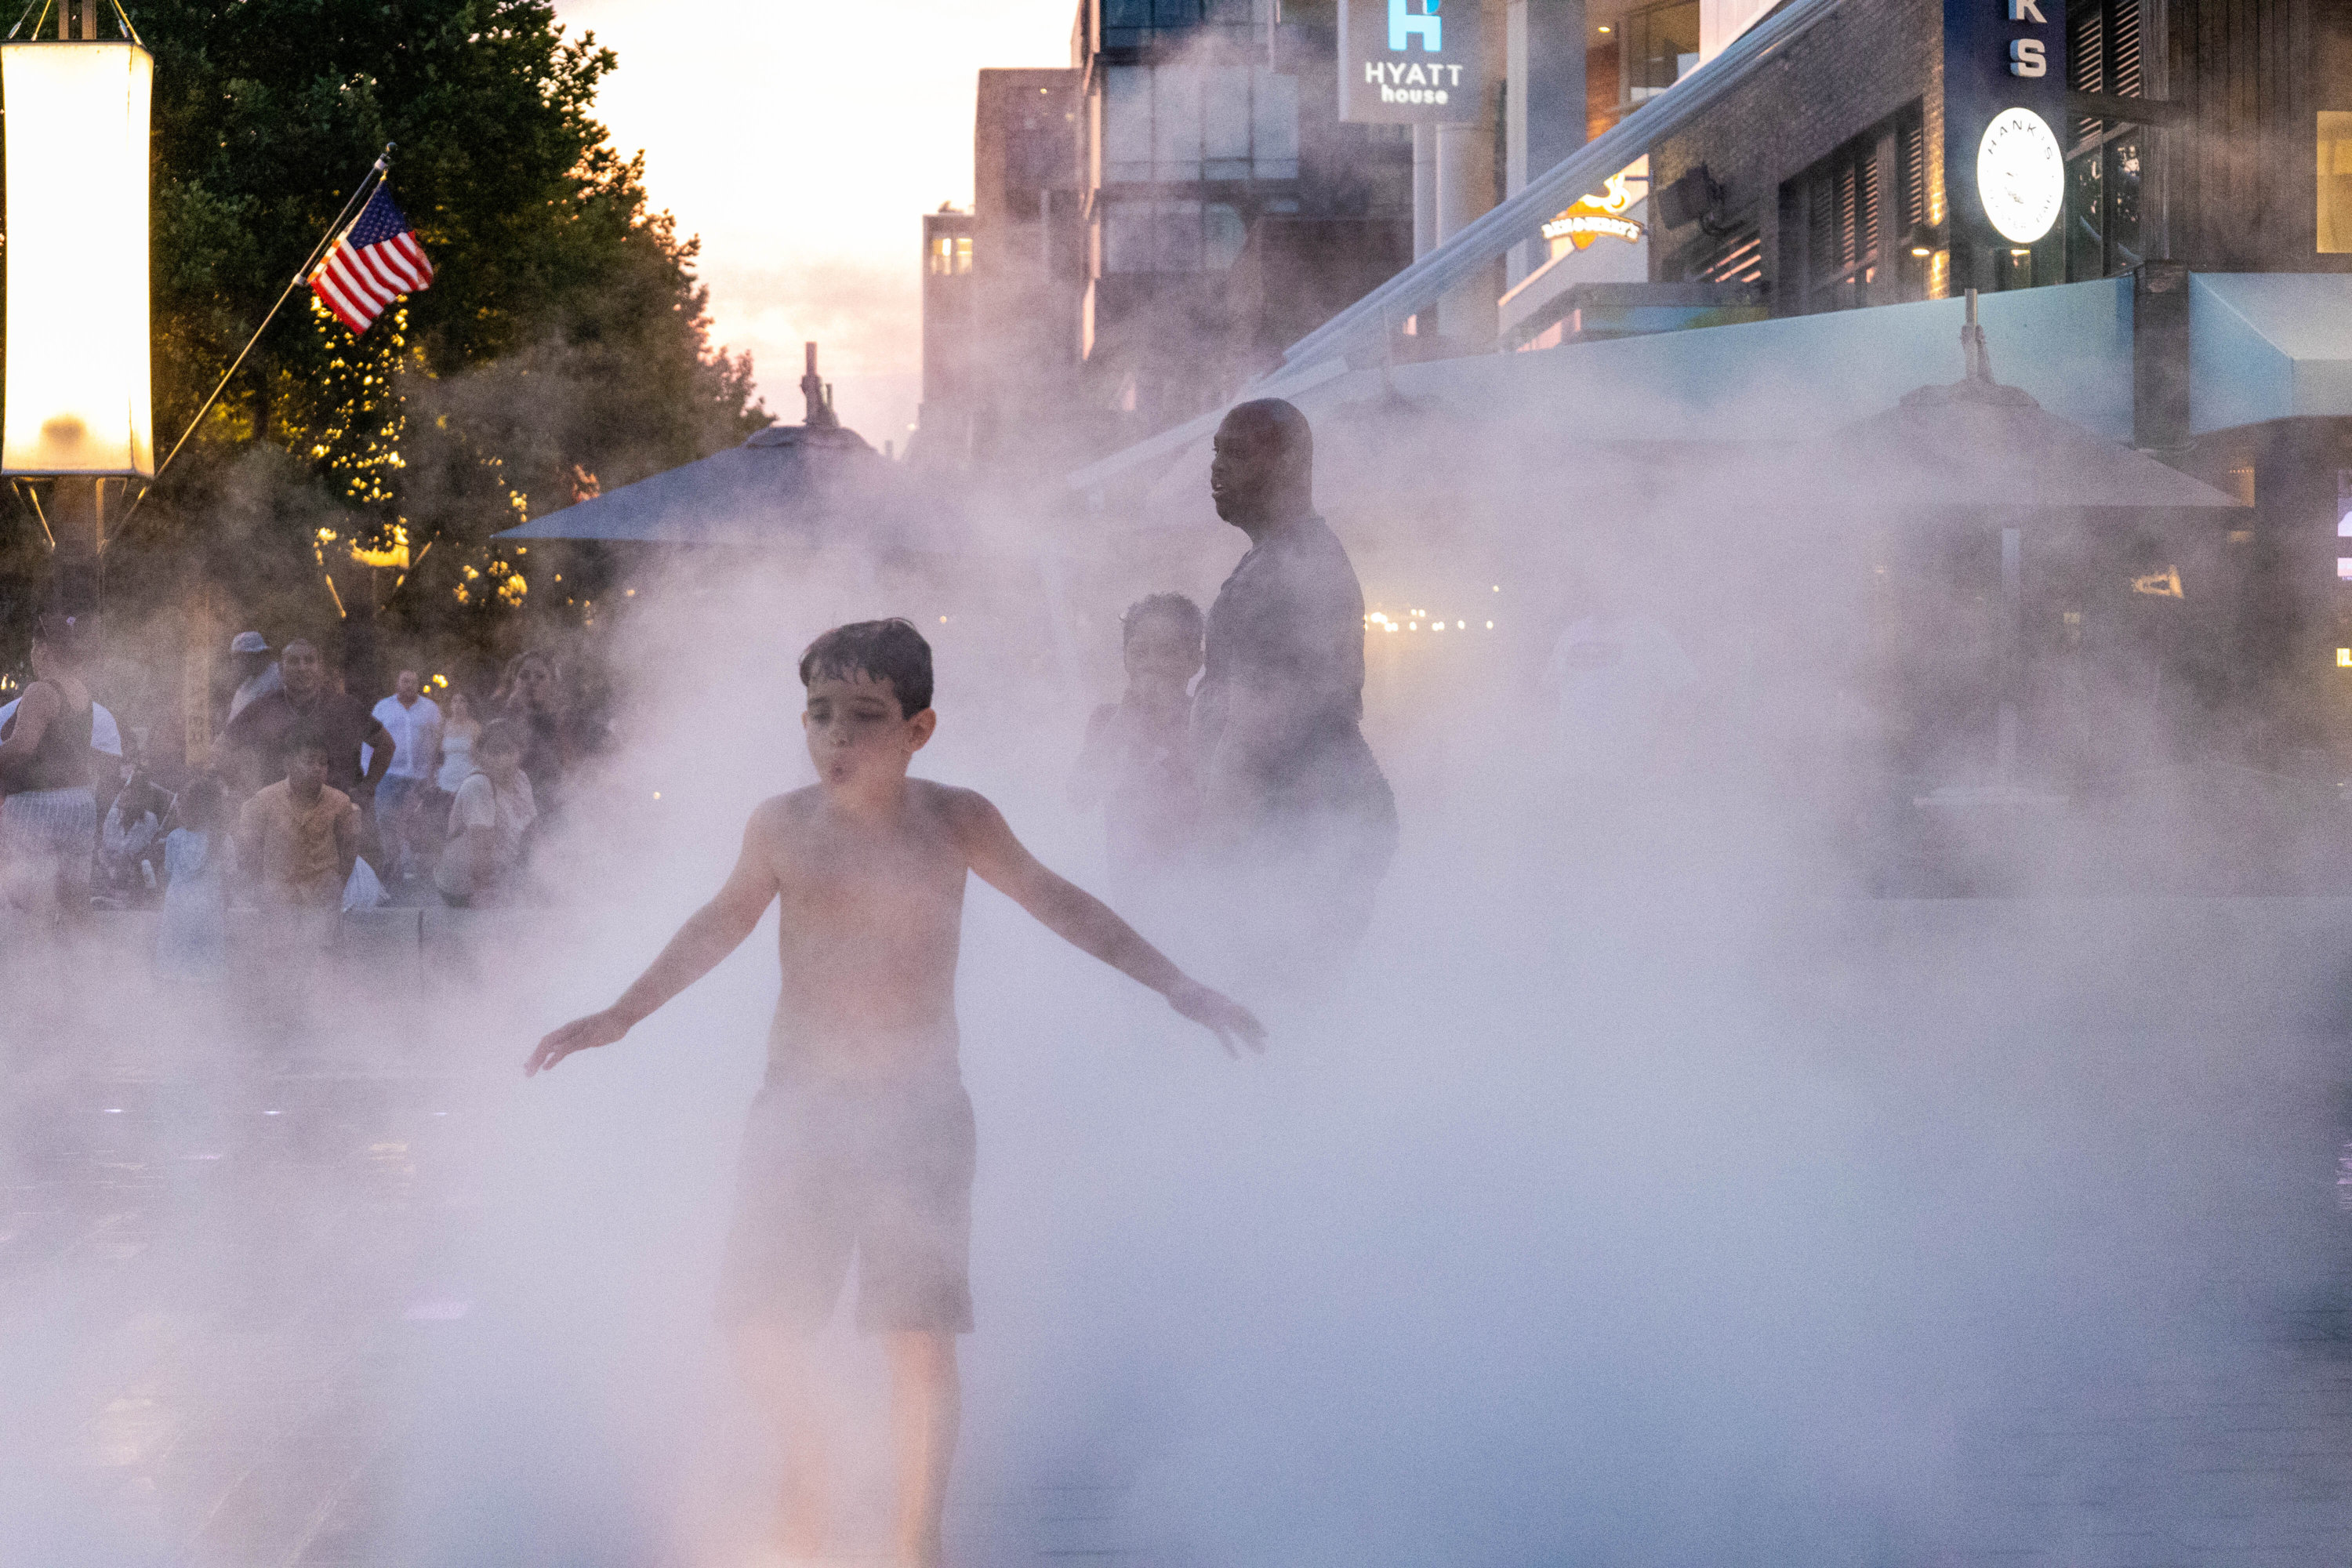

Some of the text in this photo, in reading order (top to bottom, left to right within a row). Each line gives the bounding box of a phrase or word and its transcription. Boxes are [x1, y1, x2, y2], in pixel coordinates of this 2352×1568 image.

[1365, 61, 1464, 86] HYATT
[1381, 83, 1448, 104] house
[1987, 119, 2053, 160] HANK'S
